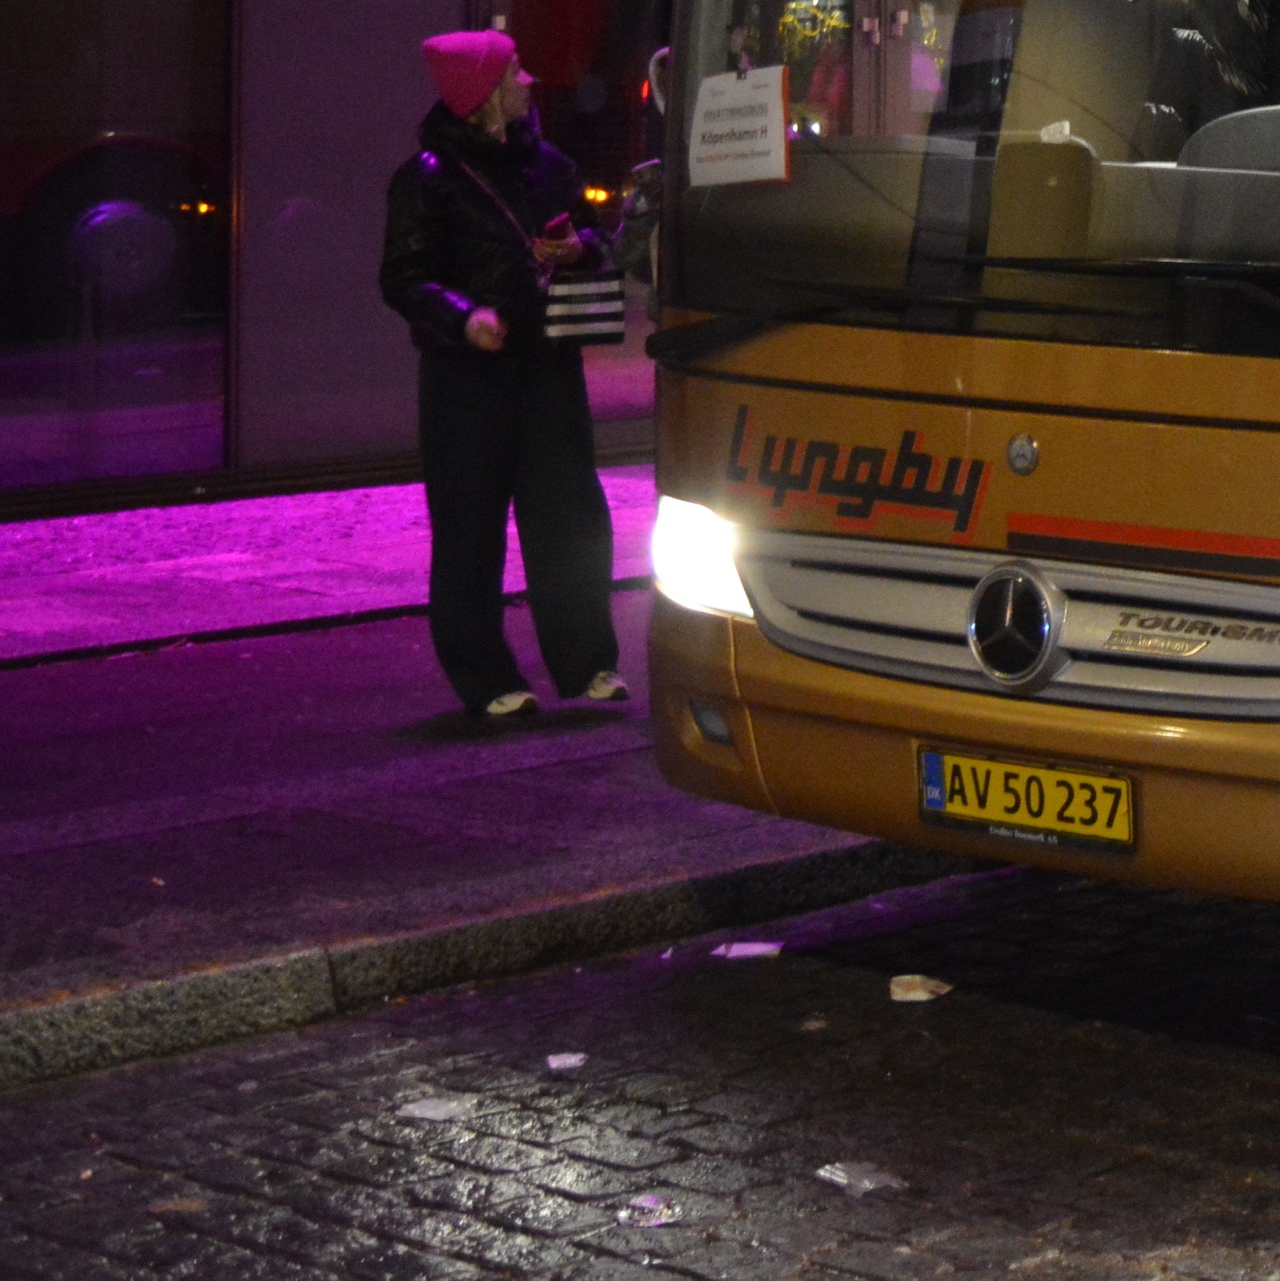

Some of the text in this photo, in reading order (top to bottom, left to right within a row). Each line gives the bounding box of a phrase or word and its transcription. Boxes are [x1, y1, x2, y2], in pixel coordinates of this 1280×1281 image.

[761, 124, 768, 138] H
[727, 404, 990, 540] Lyngby
[927, 785, 941, 799] DK
[947, 764, 1122, 829] AV 50 237
